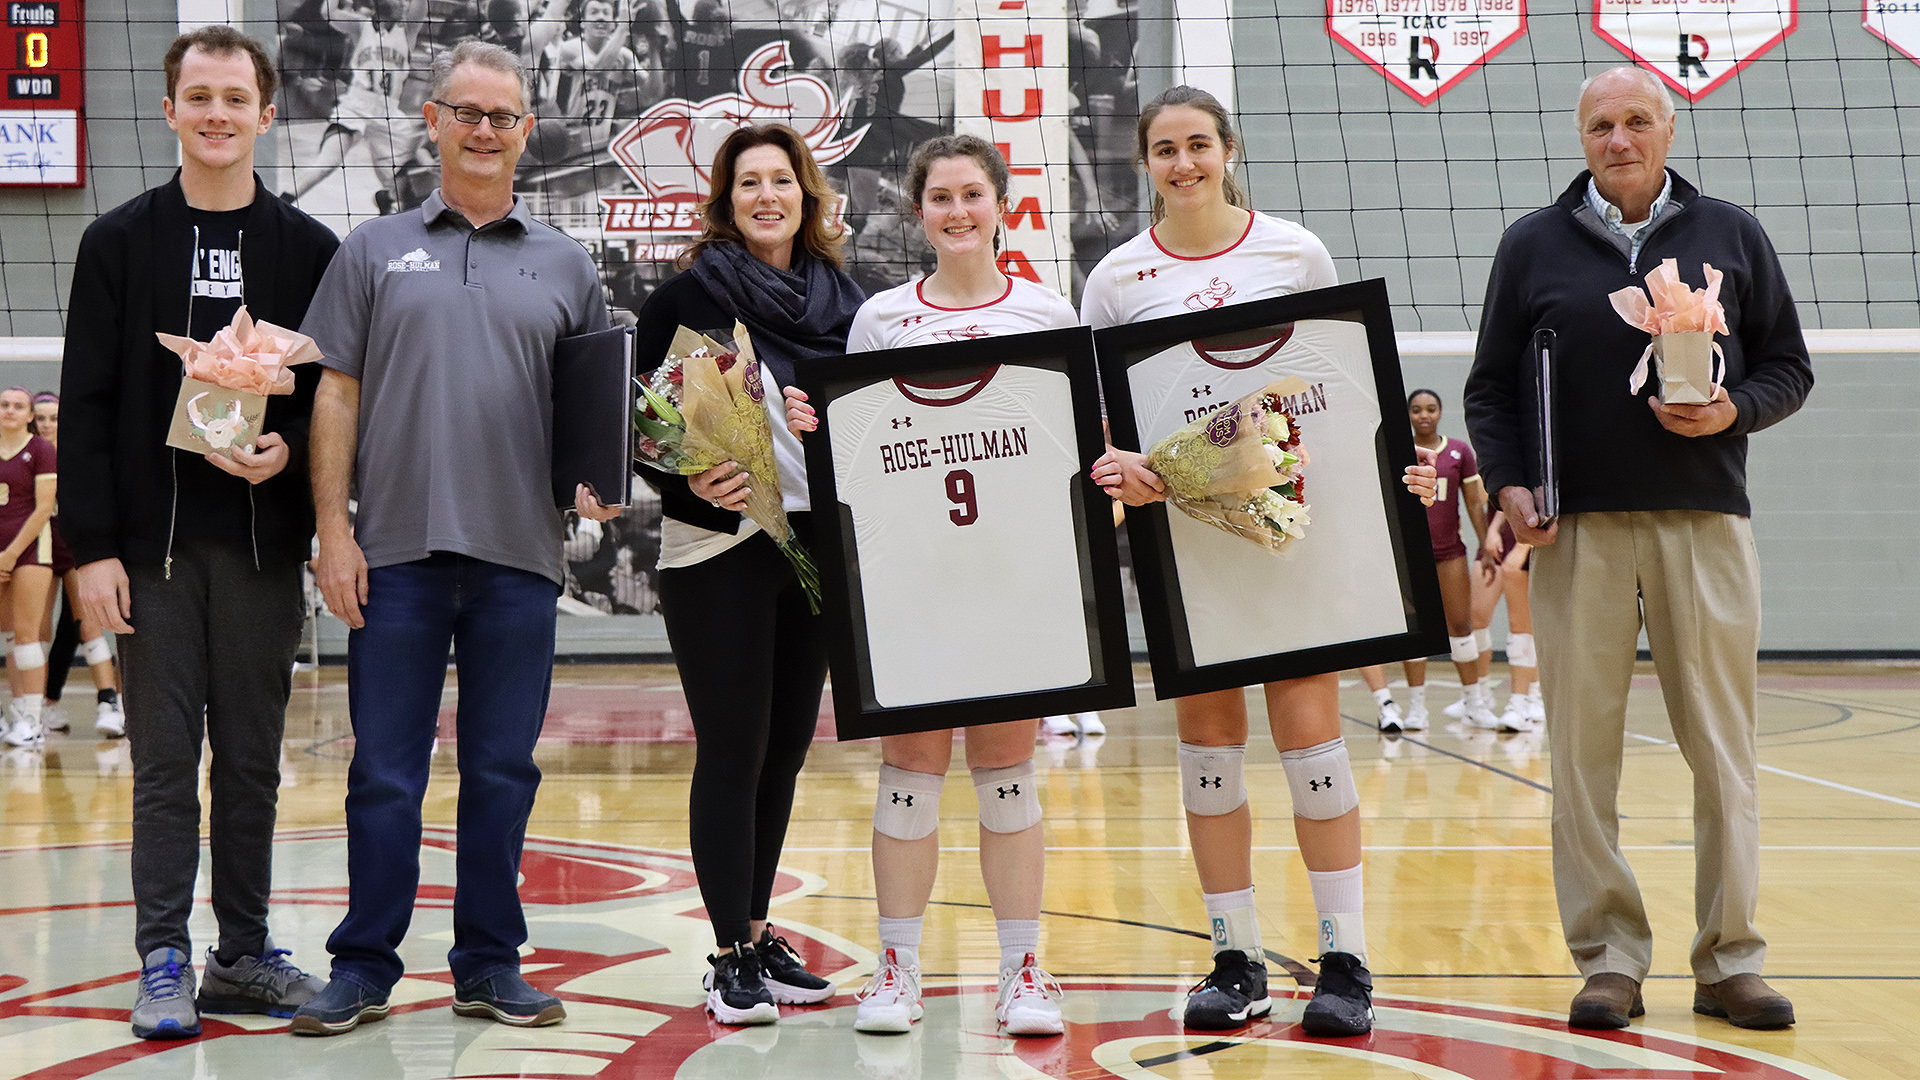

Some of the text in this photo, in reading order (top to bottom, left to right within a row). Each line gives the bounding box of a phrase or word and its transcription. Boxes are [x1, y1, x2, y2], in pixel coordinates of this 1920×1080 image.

[1338, 0, 1375, 13] 1976
[1385, 0, 1420, 13] 1977
[1431, 0, 1467, 12] 1978
[1402, 16, 1448, 29] ICAC
[1361, 32, 1397, 47] 1996
[1453, 31, 1490, 46] 1997
[26, 32, 48, 68] 0
[16, 78, 53, 95] won
[880, 426, 1029, 474] ROSE-HULMAN
[944, 469, 979, 527] 9
